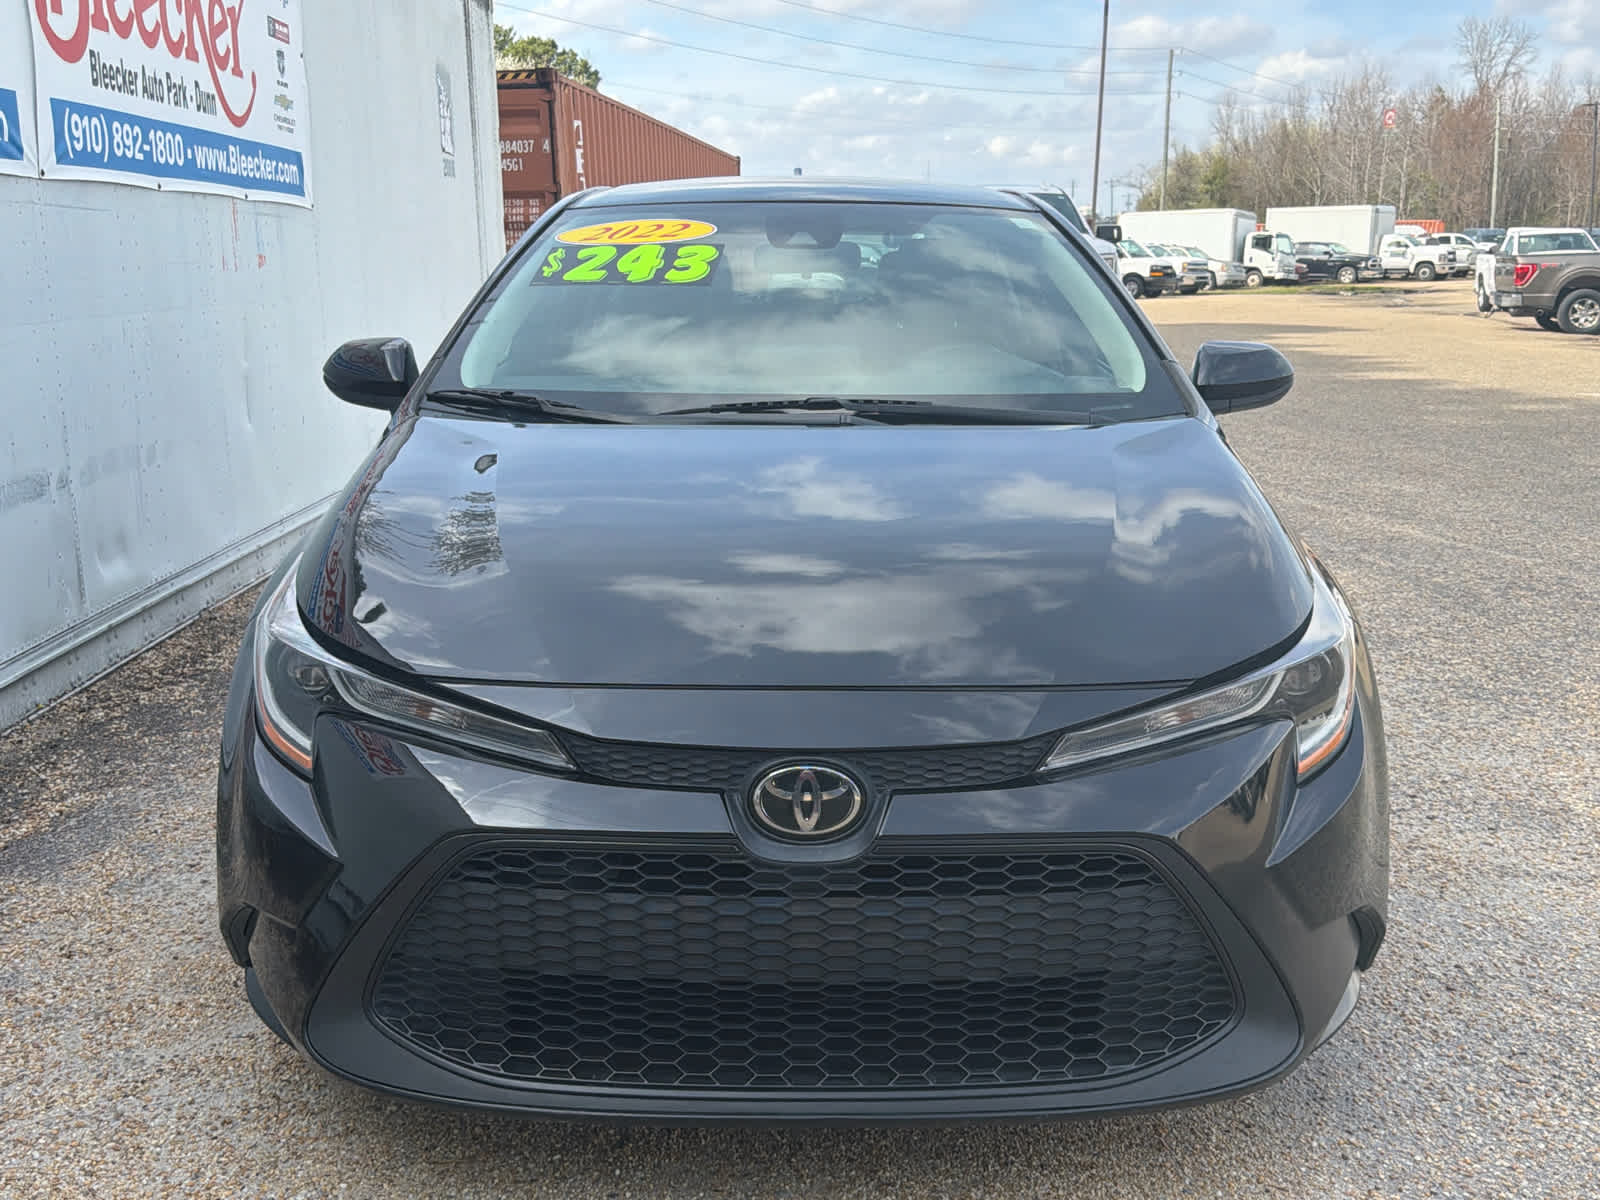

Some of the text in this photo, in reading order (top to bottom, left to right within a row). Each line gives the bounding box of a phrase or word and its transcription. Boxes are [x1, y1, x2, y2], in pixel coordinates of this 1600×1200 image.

[89, 49, 217, 116] Bleecker Auto Park Dunn
[64, 107, 300, 185] (910) 892-1800 www.Bleecker.com
[579, 223, 691, 242] 2022
